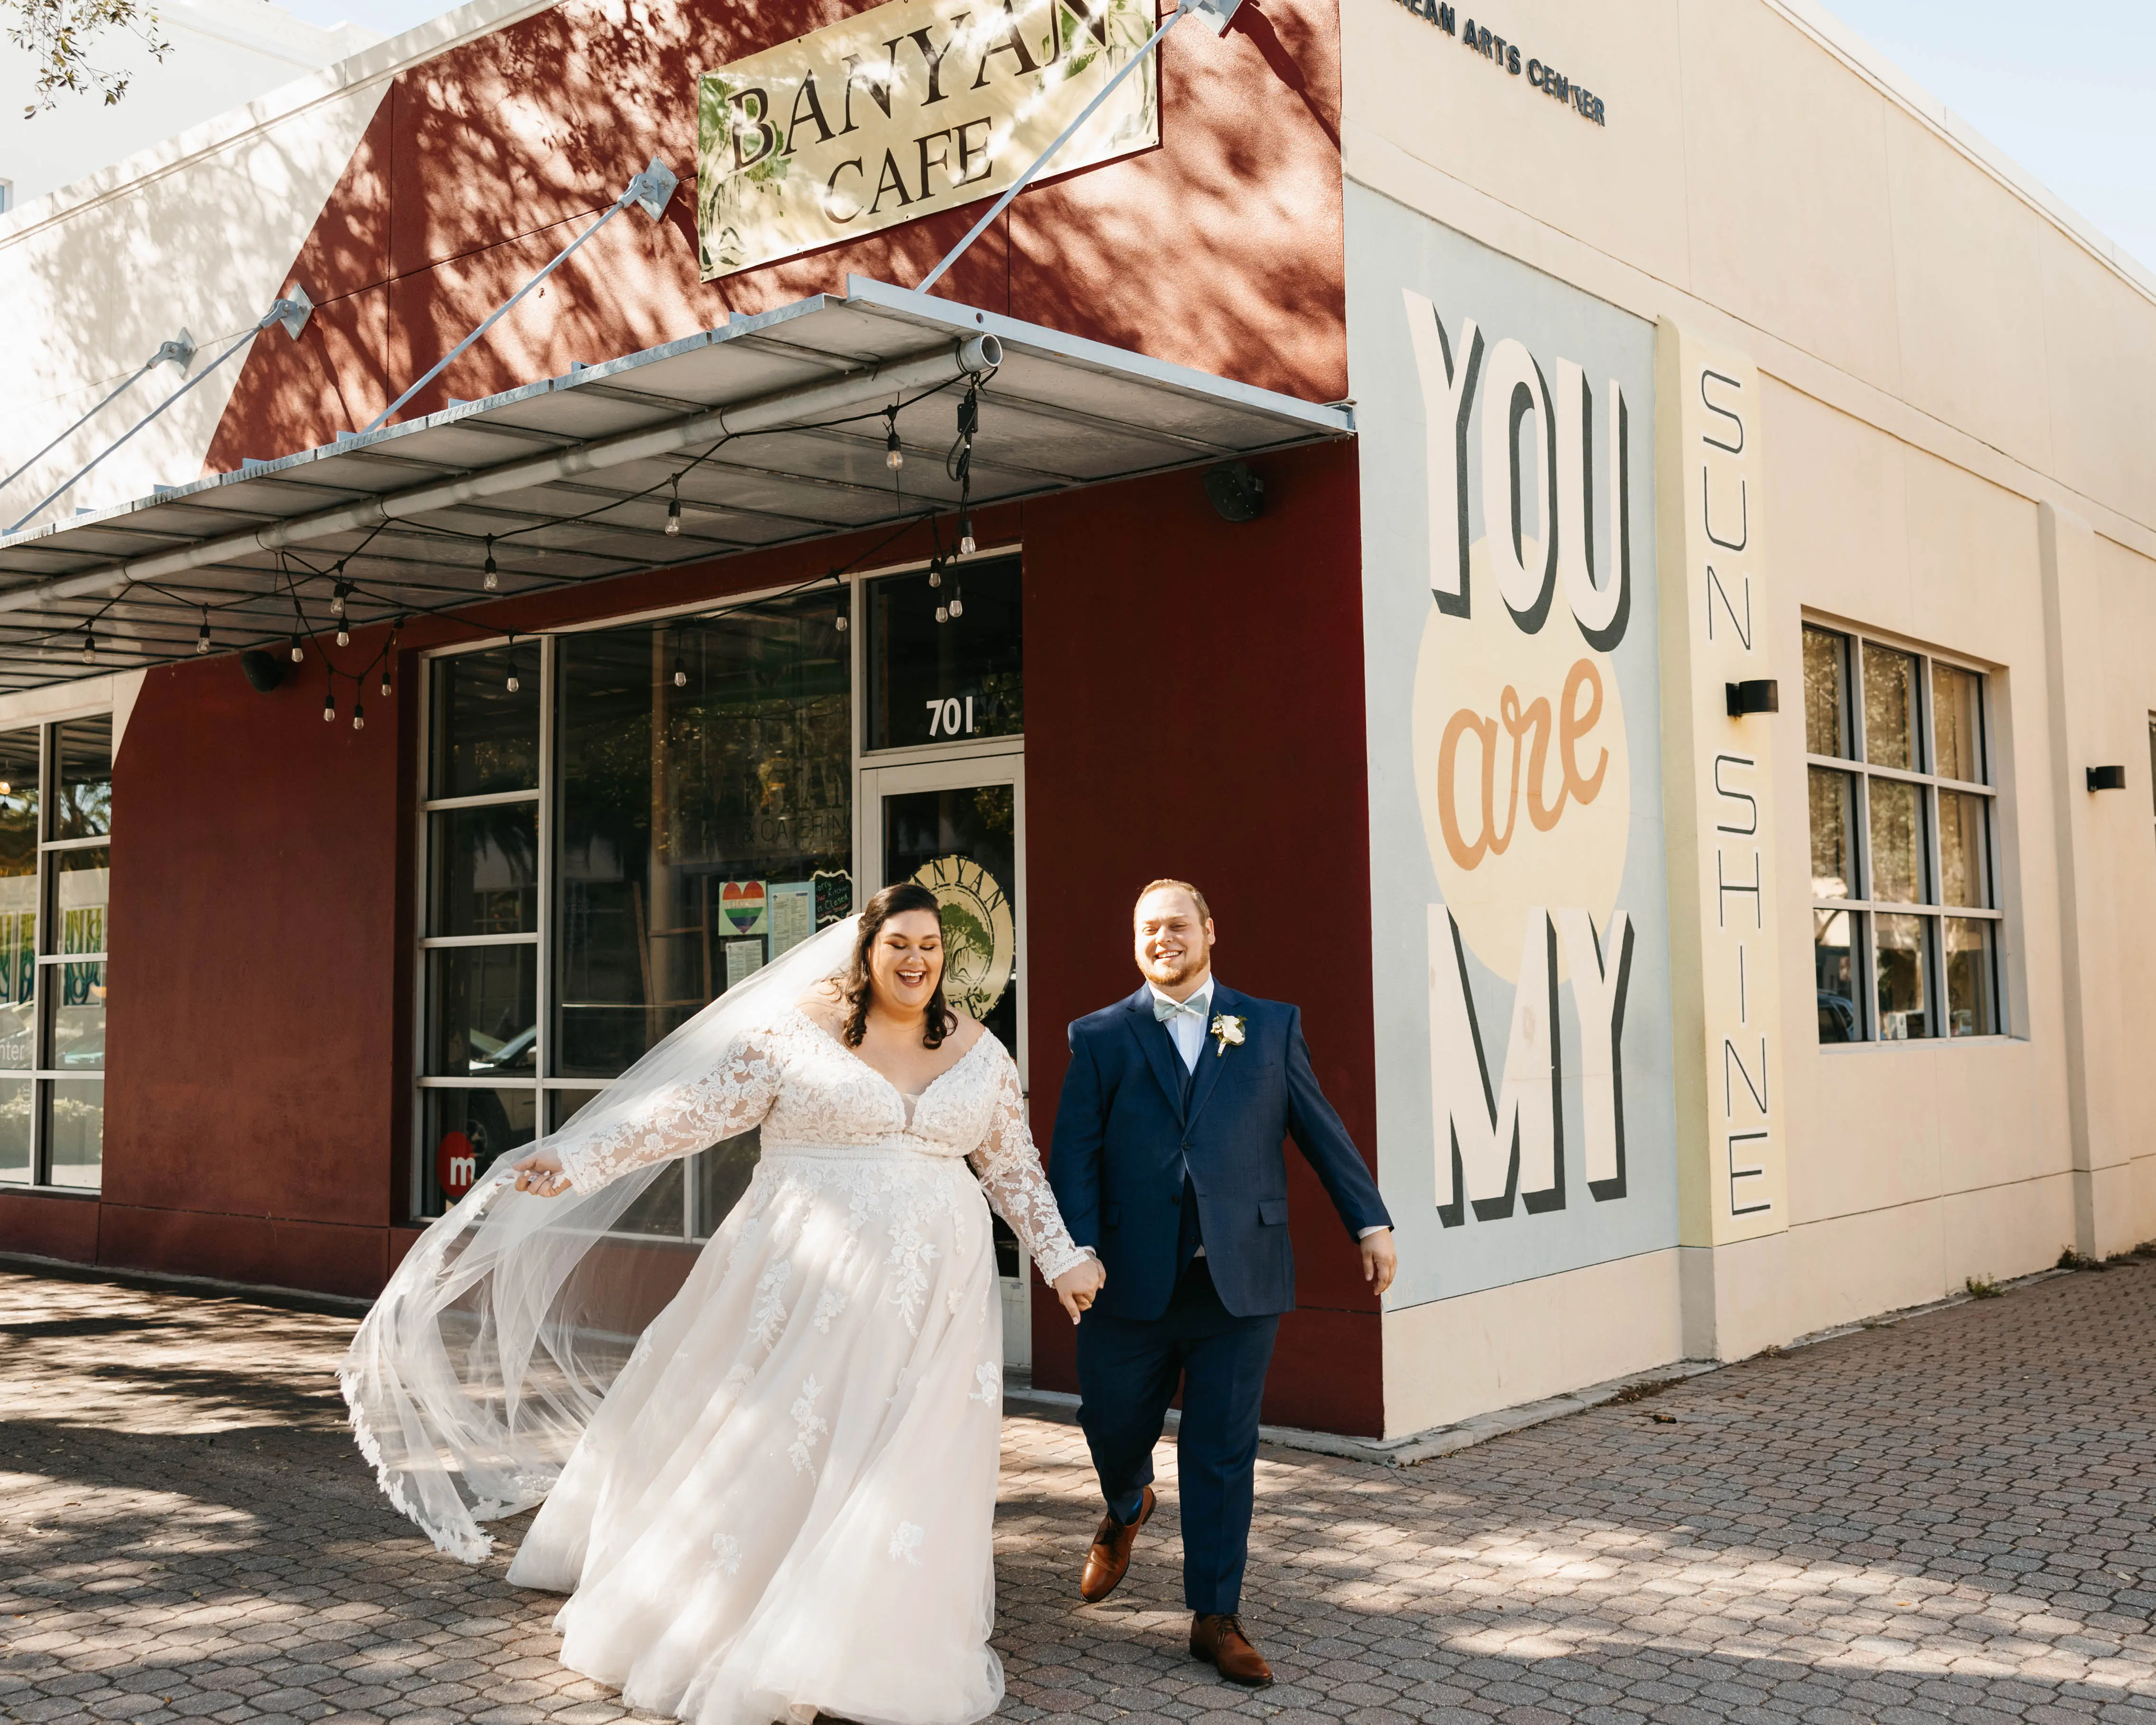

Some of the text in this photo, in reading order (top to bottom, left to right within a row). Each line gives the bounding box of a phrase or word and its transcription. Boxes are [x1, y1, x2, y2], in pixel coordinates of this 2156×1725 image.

[727, 0, 1106, 174] BANYAN
[1395, 0, 1605, 127] EAN ARTS CENTER
[824, 116, 993, 224] CAFE
[1402, 287, 1631, 652] YOU
[926, 696, 973, 737] 701
[1437, 658, 1609, 871] are
[816, 881, 832, 891] orry
[1427, 903, 1635, 1229] MY
[450, 1157, 476, 1186] m
